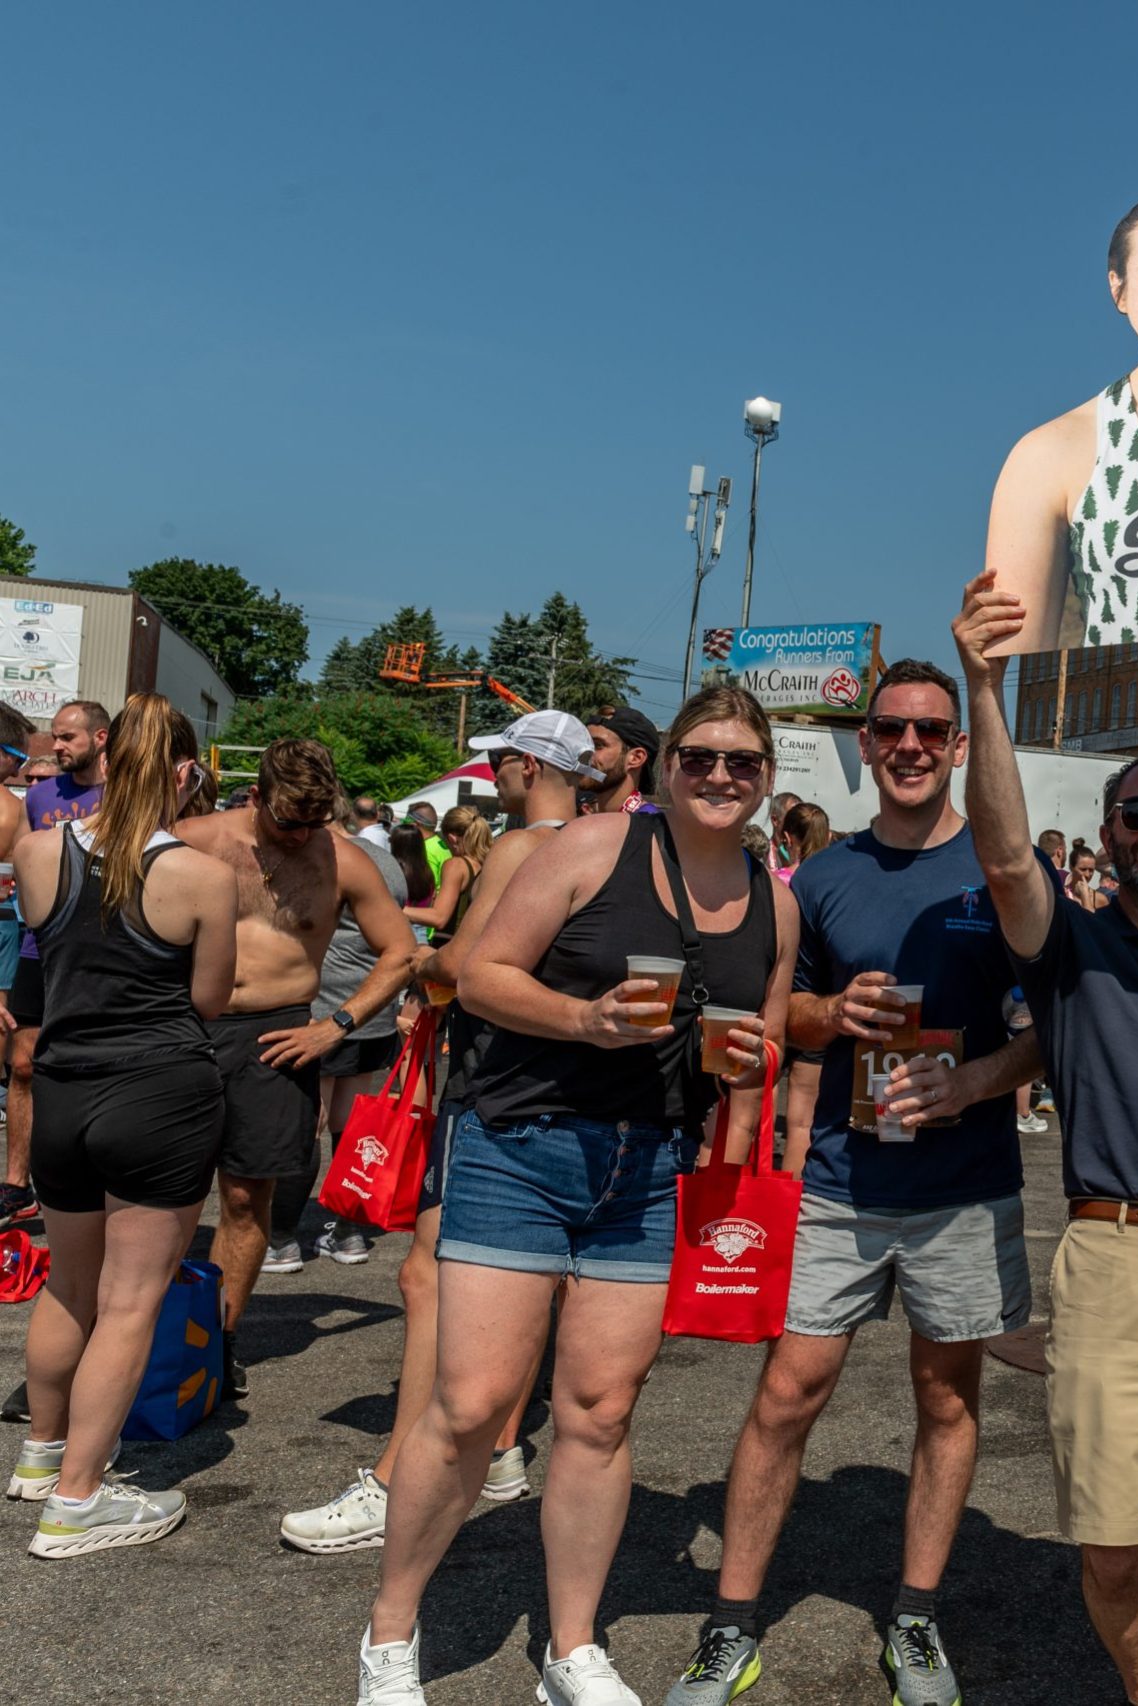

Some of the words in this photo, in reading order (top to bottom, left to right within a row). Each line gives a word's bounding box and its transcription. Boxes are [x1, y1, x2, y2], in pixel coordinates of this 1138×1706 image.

[739, 627, 855, 652] Congratulations
[776, 648, 822, 665] Runners
[708, 1223, 759, 1239] Hannaford
[702, 1264, 756, 1273] hannaford.com
[695, 1282, 759, 1295] Boilermaker
